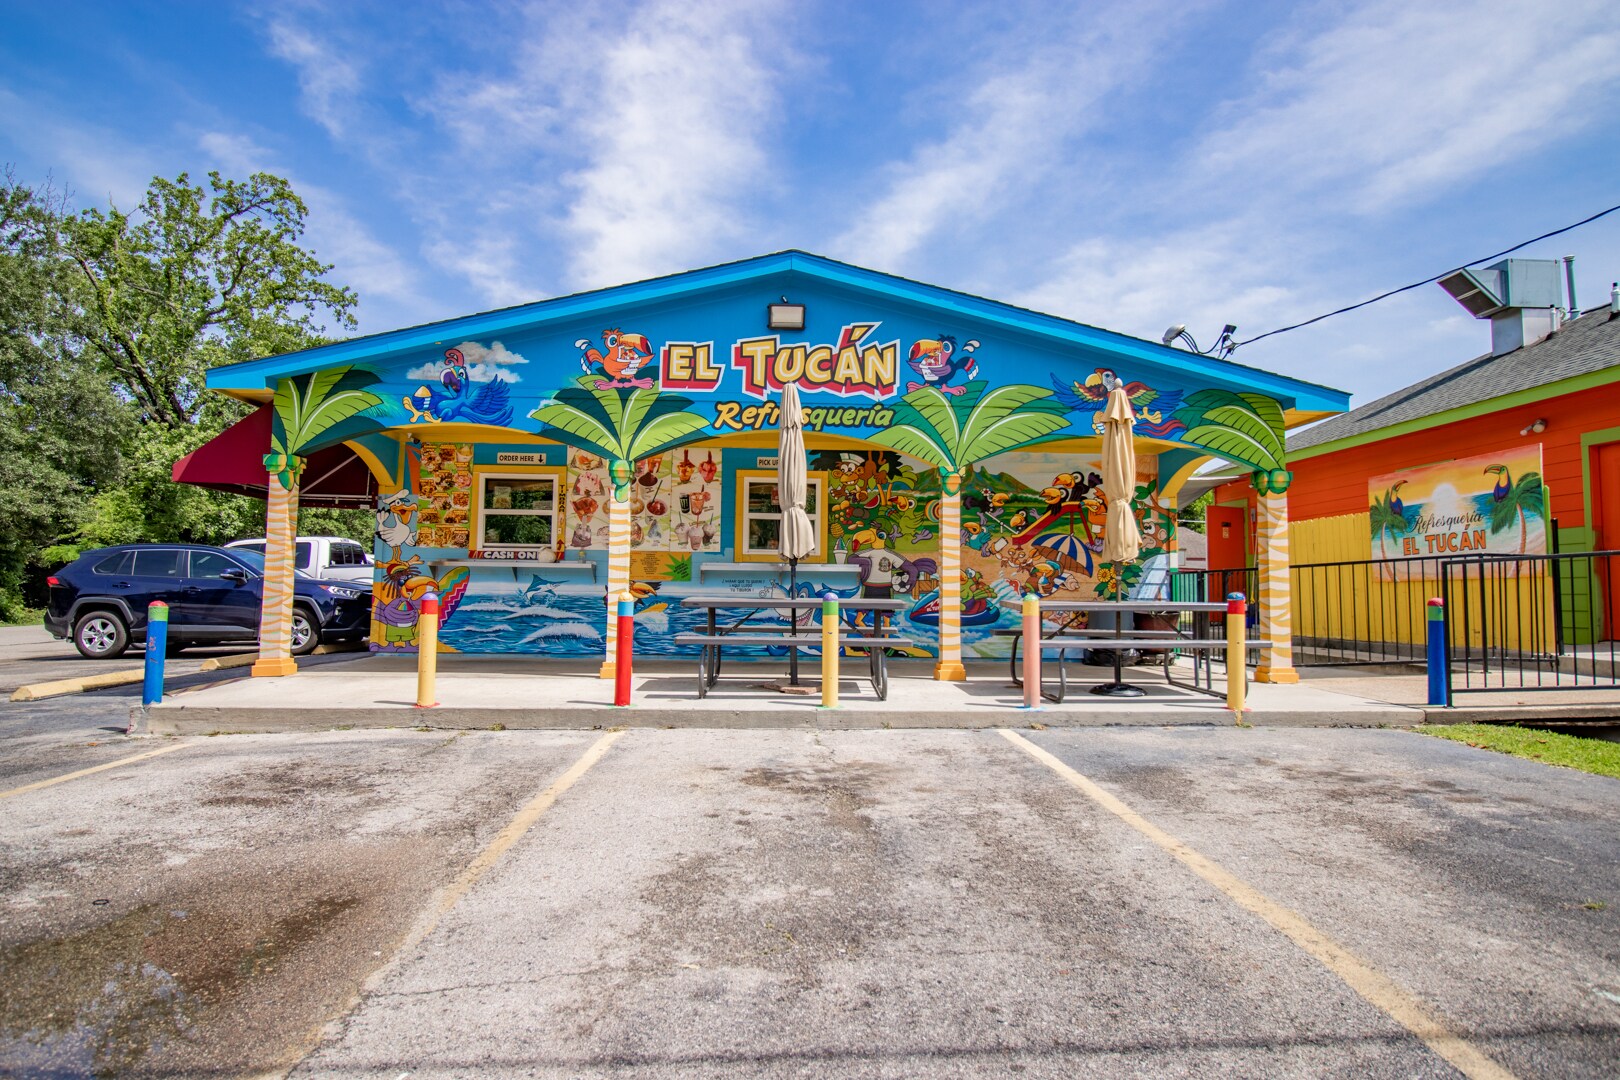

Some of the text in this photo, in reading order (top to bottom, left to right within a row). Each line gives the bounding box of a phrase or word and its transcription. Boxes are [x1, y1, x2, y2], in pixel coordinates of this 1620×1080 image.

[661, 321, 900, 399] EL TUCÁN
[714, 400, 895, 431] Refrsquería
[483, 551, 538, 559] CASH ON
[1403, 524, 1487, 556] EL TUCÁN
